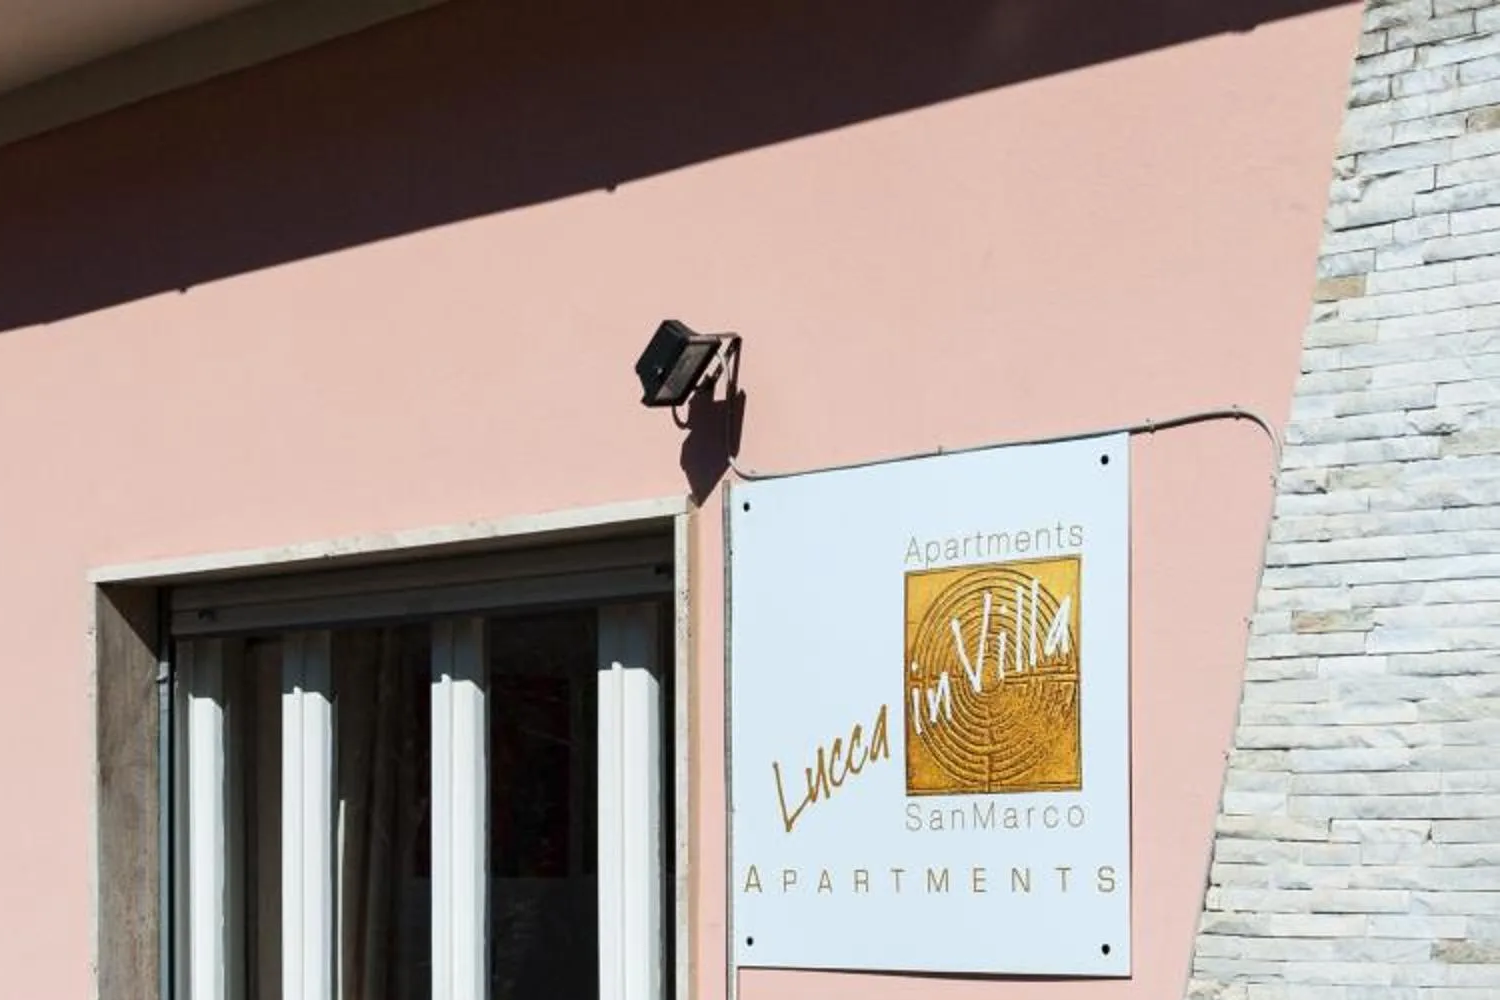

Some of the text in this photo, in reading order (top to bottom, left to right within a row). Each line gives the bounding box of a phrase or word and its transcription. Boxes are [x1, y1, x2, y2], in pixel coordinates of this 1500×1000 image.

[904, 521, 1084, 566] Apartments
[772, 577, 1073, 832] Lucca in Villa
[743, 864, 1116, 893] APARTMENTS
